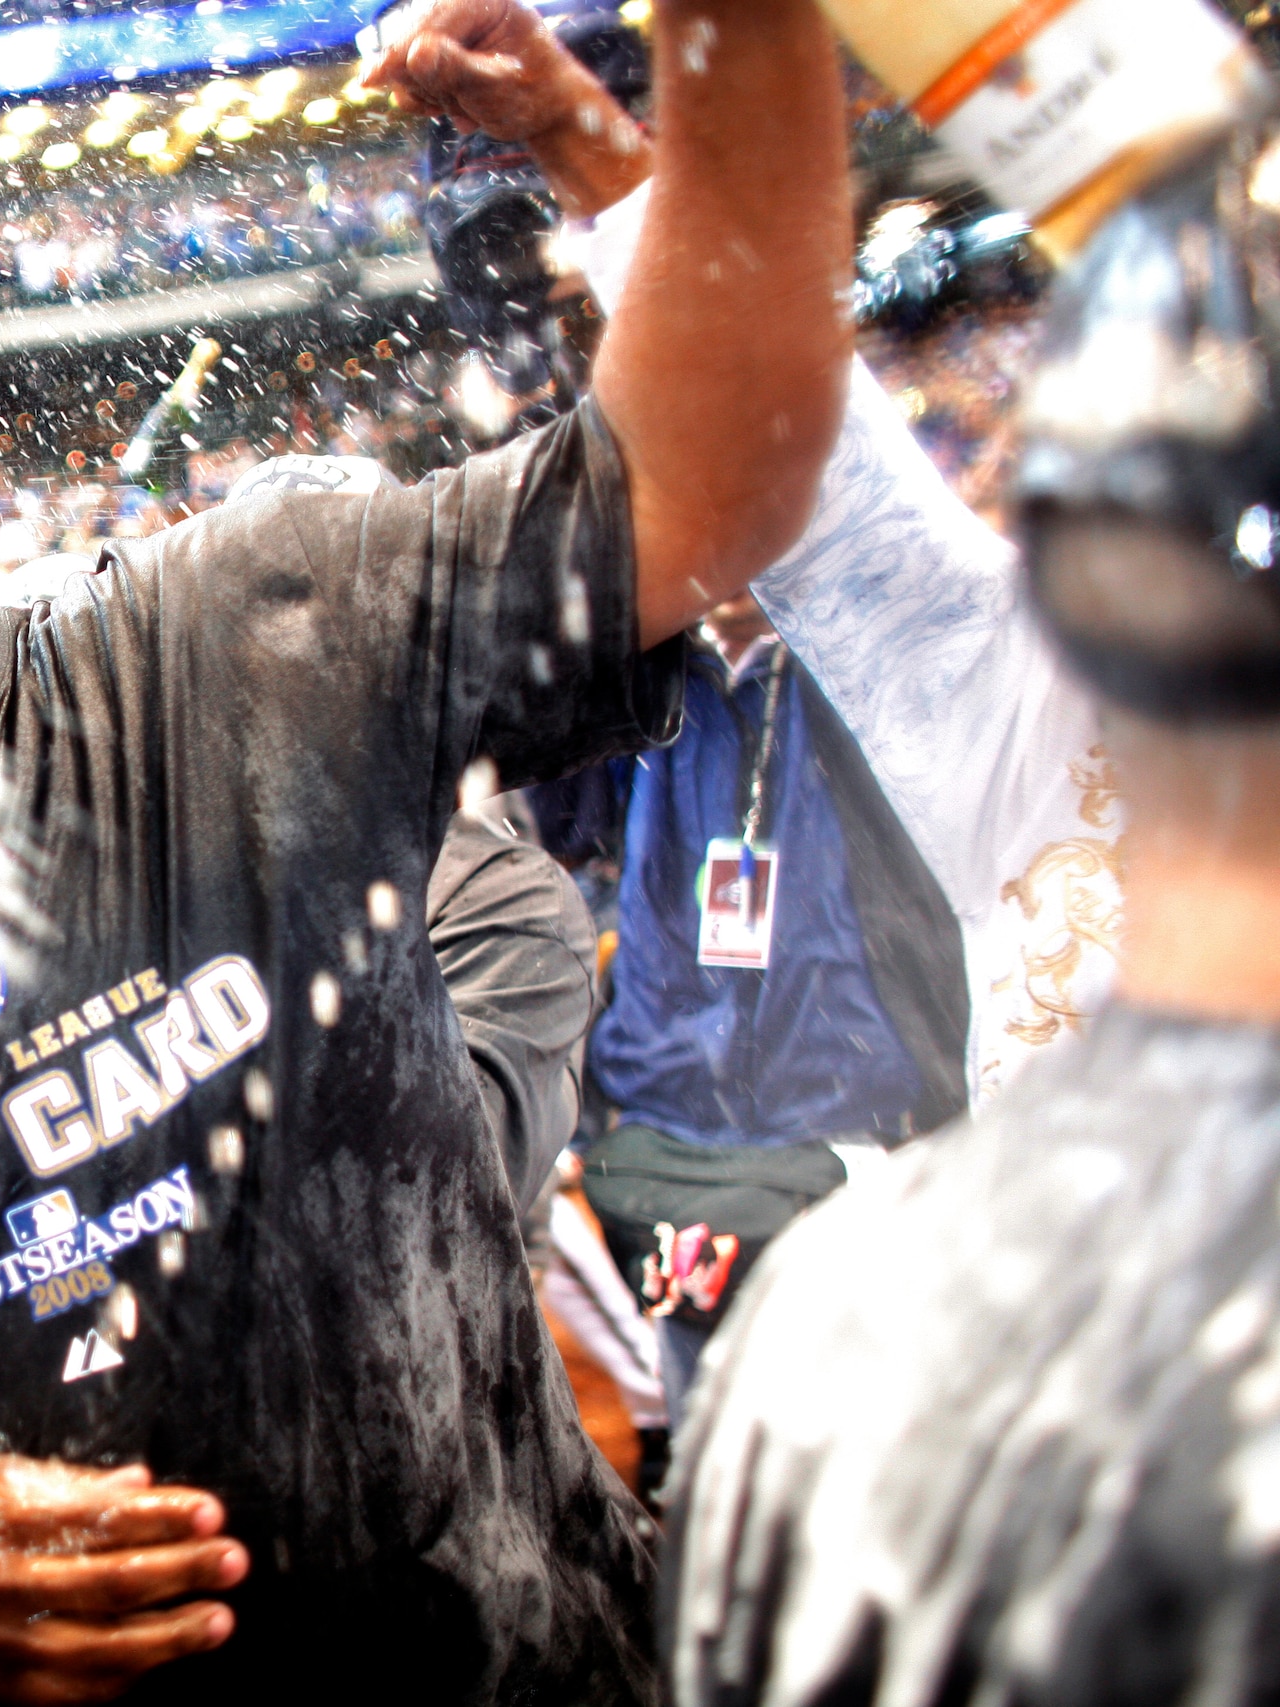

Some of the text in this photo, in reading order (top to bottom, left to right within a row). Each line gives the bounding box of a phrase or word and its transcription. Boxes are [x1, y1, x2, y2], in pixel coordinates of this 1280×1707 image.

[1, 954, 271, 1179] CARD
[6, 968, 167, 1072] LEAGUE
[30, 1262, 114, 1322] 2008
